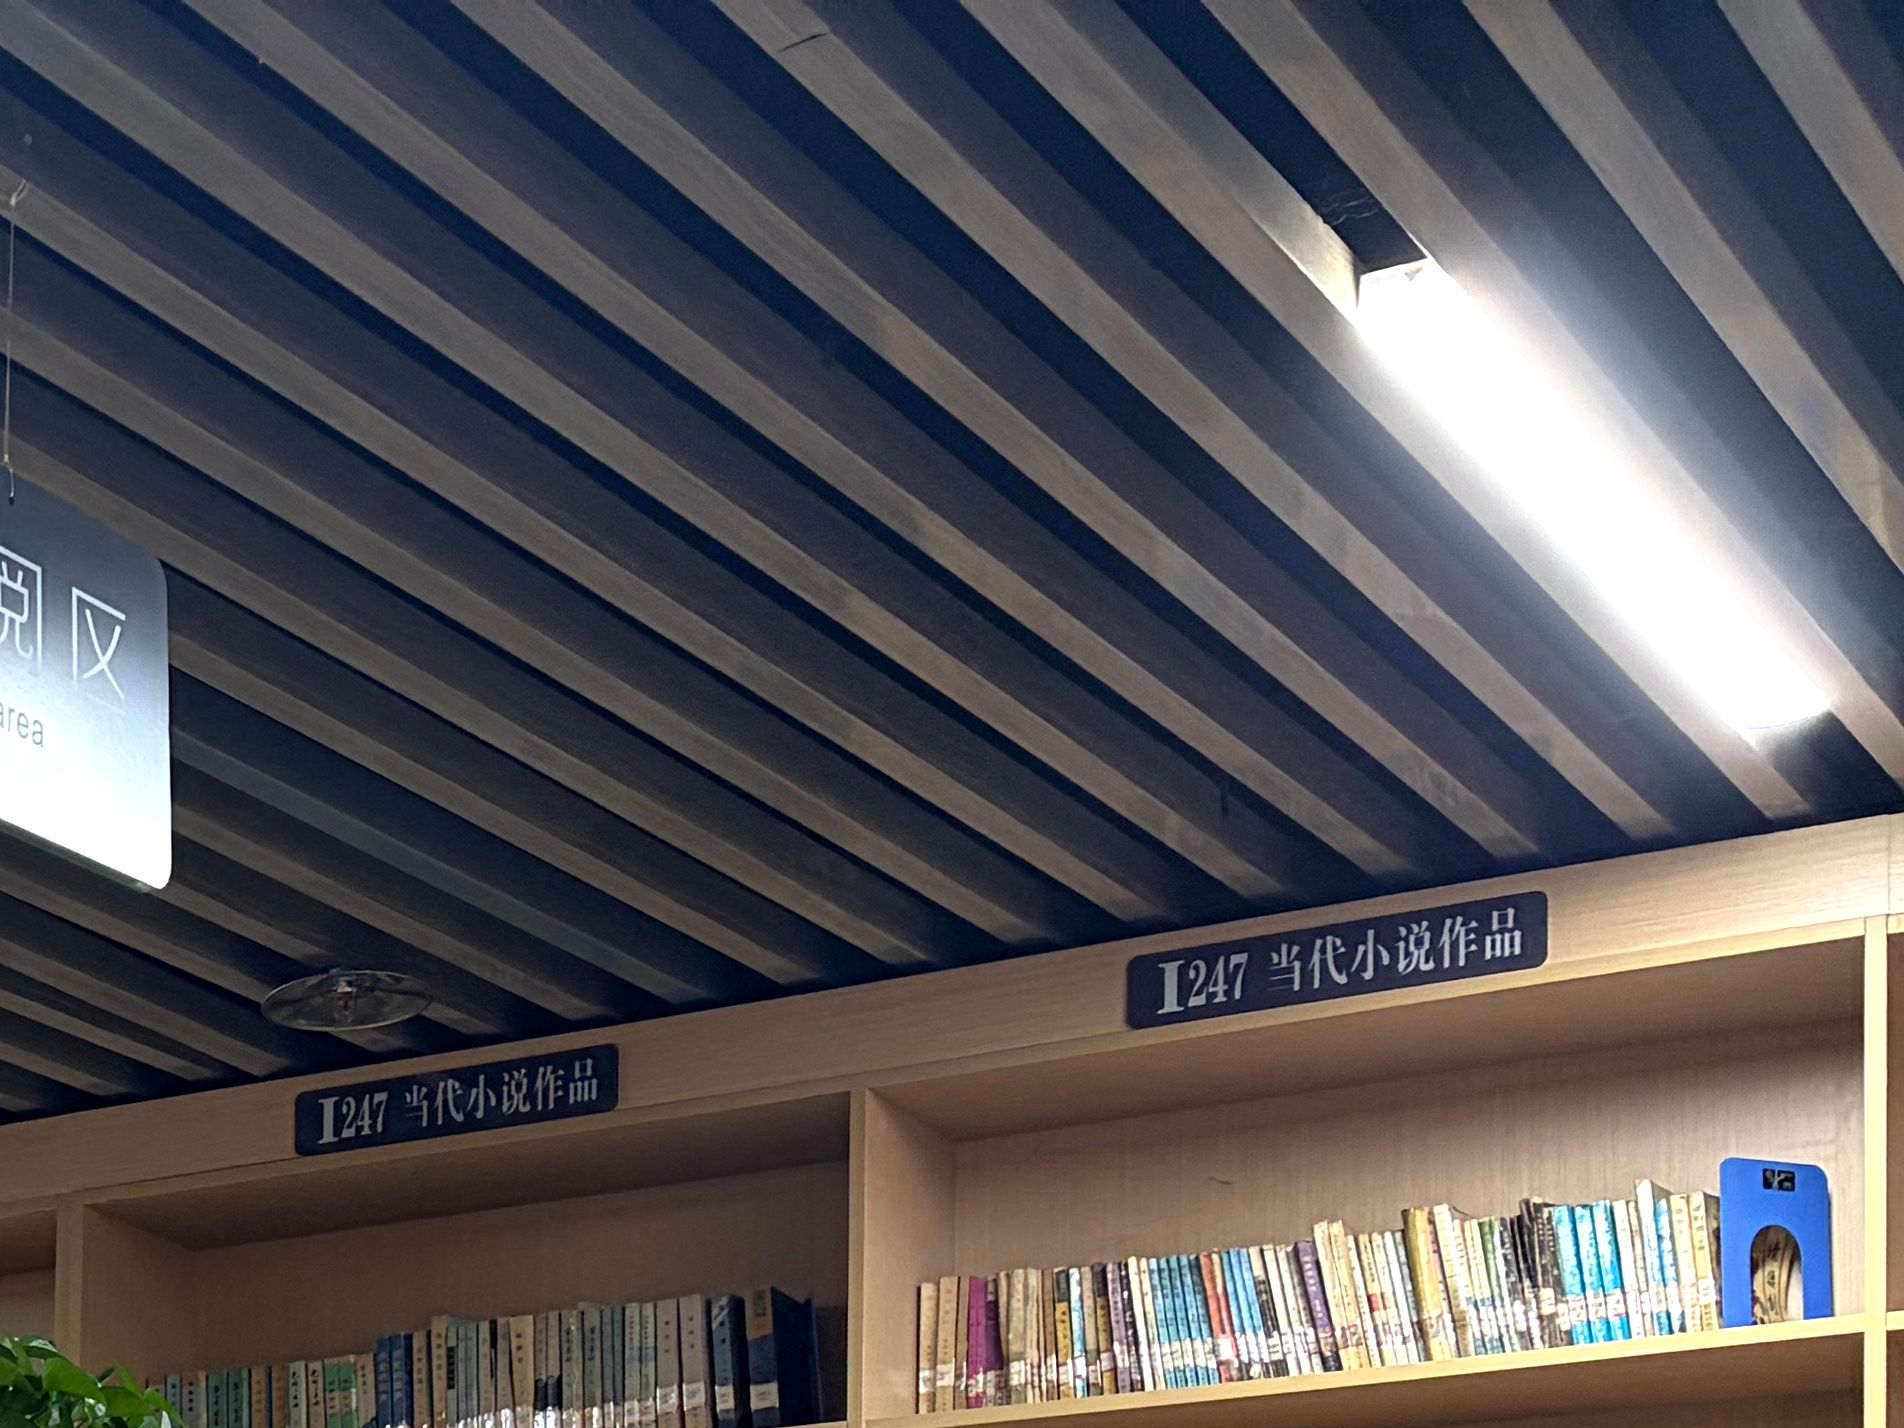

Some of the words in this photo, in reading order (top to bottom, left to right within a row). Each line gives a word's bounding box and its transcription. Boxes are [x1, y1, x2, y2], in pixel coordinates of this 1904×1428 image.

[1157, 950, 1250, 1015] I247
[1266, 904, 1524, 997] 当代小说作品
[318, 1091, 389, 1145] I247
[404, 1057, 598, 1128] 当代小说作品
